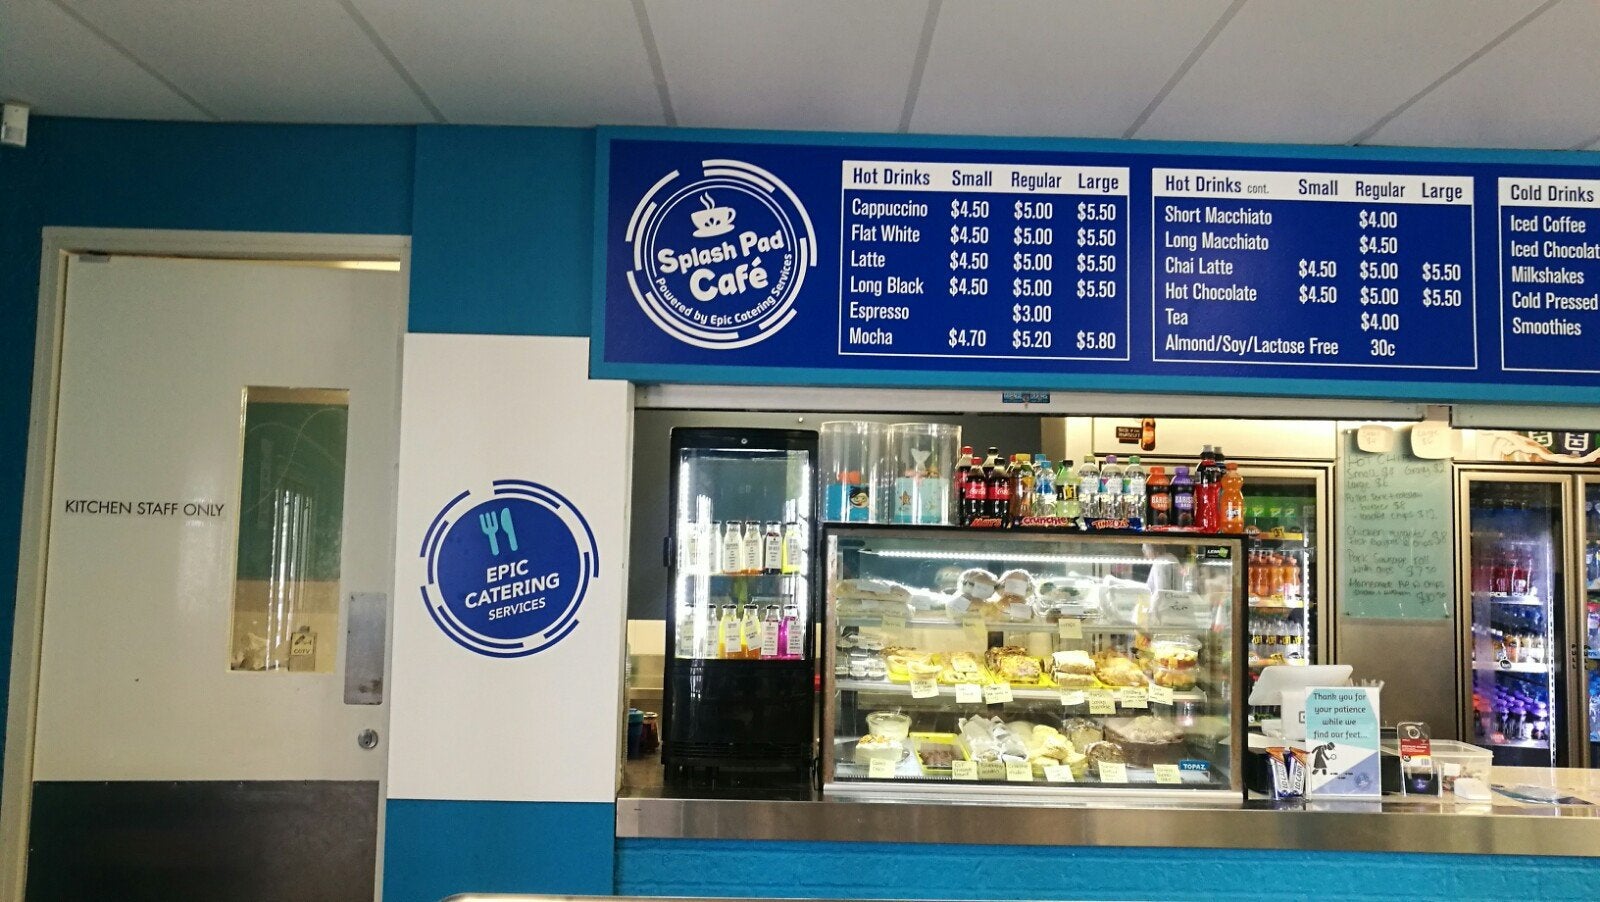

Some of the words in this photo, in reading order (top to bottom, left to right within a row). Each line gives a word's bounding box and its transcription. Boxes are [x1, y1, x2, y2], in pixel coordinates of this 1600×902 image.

[854, 168, 877, 183] Hot
[884, 169, 929, 185] Drinks
[952, 170, 992, 186] Small
[1012, 172, 1061, 191] Regular
[1079, 173, 1118, 192] Large
[1166, 175, 1189, 191] Hot
[1196, 176, 1241, 192] Drinks
[1248, 185, 1269, 193] cont.
[1299, 179, 1337, 195] Small
[1356, 181, 1405, 200] Regular
[1422, 183, 1462, 202] Large
[1511, 184, 1541, 200] Cold
[1549, 186, 1593, 202] Drinks
[853, 198, 927, 218] Cappuccino
[951, 199, 989, 219] $4.50
[1014, 200, 1052, 220] $5.00
[1078, 202, 1116, 221] $5.50
[1165, 206, 1200, 223] Short
[1206, 207, 1272, 225] Macchiato
[1359, 210, 1397, 229] $4.00
[852, 224, 873, 241] Flat
[883, 225, 919, 242] White
[951, 225, 988, 244] $4.50
[1014, 226, 1052, 246] $5.00
[1078, 228, 1115, 247] $5.50
[1511, 215, 1538, 231] Iced
[1543, 216, 1585, 233] Coffee
[658, 241, 738, 274] Splash
[739, 230, 783, 257] Pad
[1166, 231, 1196, 251] Long
[1202, 232, 1268, 250] Macchiato
[1360, 235, 1397, 254] $4.50
[1512, 240, 1538, 257] Iced
[1544, 241, 1600, 259] Chocolat
[852, 250, 885, 267] Latte
[950, 250, 988, 270] $4.50
[1014, 252, 1052, 271] $5.00
[1077, 253, 1115, 273] $5.50
[1166, 257, 1193, 273] Chai
[1199, 258, 1233, 274] Latte
[1299, 259, 1336, 278] $4.50
[1360, 260, 1398, 280] $5.00
[1423, 262, 1460, 281] $5.50
[690, 255, 768, 301] Café
[1512, 266, 1584, 284] Milkshakes
[657, 277, 693, 317] Powered
[693, 309, 709, 325] by
[710, 312, 733, 326] Epic
[734, 296, 776, 323] Catering
[771, 253, 793, 297] Services
[851, 276, 882, 296] Long
[888, 277, 923, 293] Black
[950, 276, 987, 296] $4.50
[1013, 278, 1051, 297] $5.00
[1077, 279, 1115, 298] $5.50
[1166, 282, 1184, 299] Hot
[1195, 283, 1256, 301] Chocolate
[1299, 284, 1336, 304] $4.50
[1361, 286, 1398, 305] $5.00
[1423, 288, 1461, 307] $5.50
[1513, 291, 1540, 308] Cold
[1546, 292, 1598, 310] Pressed
[850, 302, 909, 321] Espresso
[1013, 303, 1051, 323] $3.00
[1165, 308, 1188, 325] Tea
[1361, 312, 1399, 331] $4.00
[1513, 317, 1581, 335] Smoothies
[850, 327, 892, 344] Mocha
[949, 328, 986, 348] $4.70
[1013, 329, 1051, 349] $5.20
[1077, 330, 1115, 350] $5.80
[1166, 334, 1305, 355] Almond/Soy/Lactose
[1310, 338, 1338, 354] Free
[1371, 339, 1395, 356] 30c
[65, 499, 132, 514] KITCHEN
[136, 501, 179, 515] STAFF
[183, 503, 225, 517] ONLY
[486, 559, 529, 583] EPIC
[465, 572, 560, 609] CATERING
[488, 597, 546, 621] SERVICES
[1313, 692, 1337, 701] Thank
[1339, 693, 1353, 702] you
[1355, 692, 1367, 702] for
[1314, 706, 1332, 714] your
[1334, 705, 1366, 714] patience
[1322, 718, 1343, 726] while
[1313, 730, 1329, 739] find
